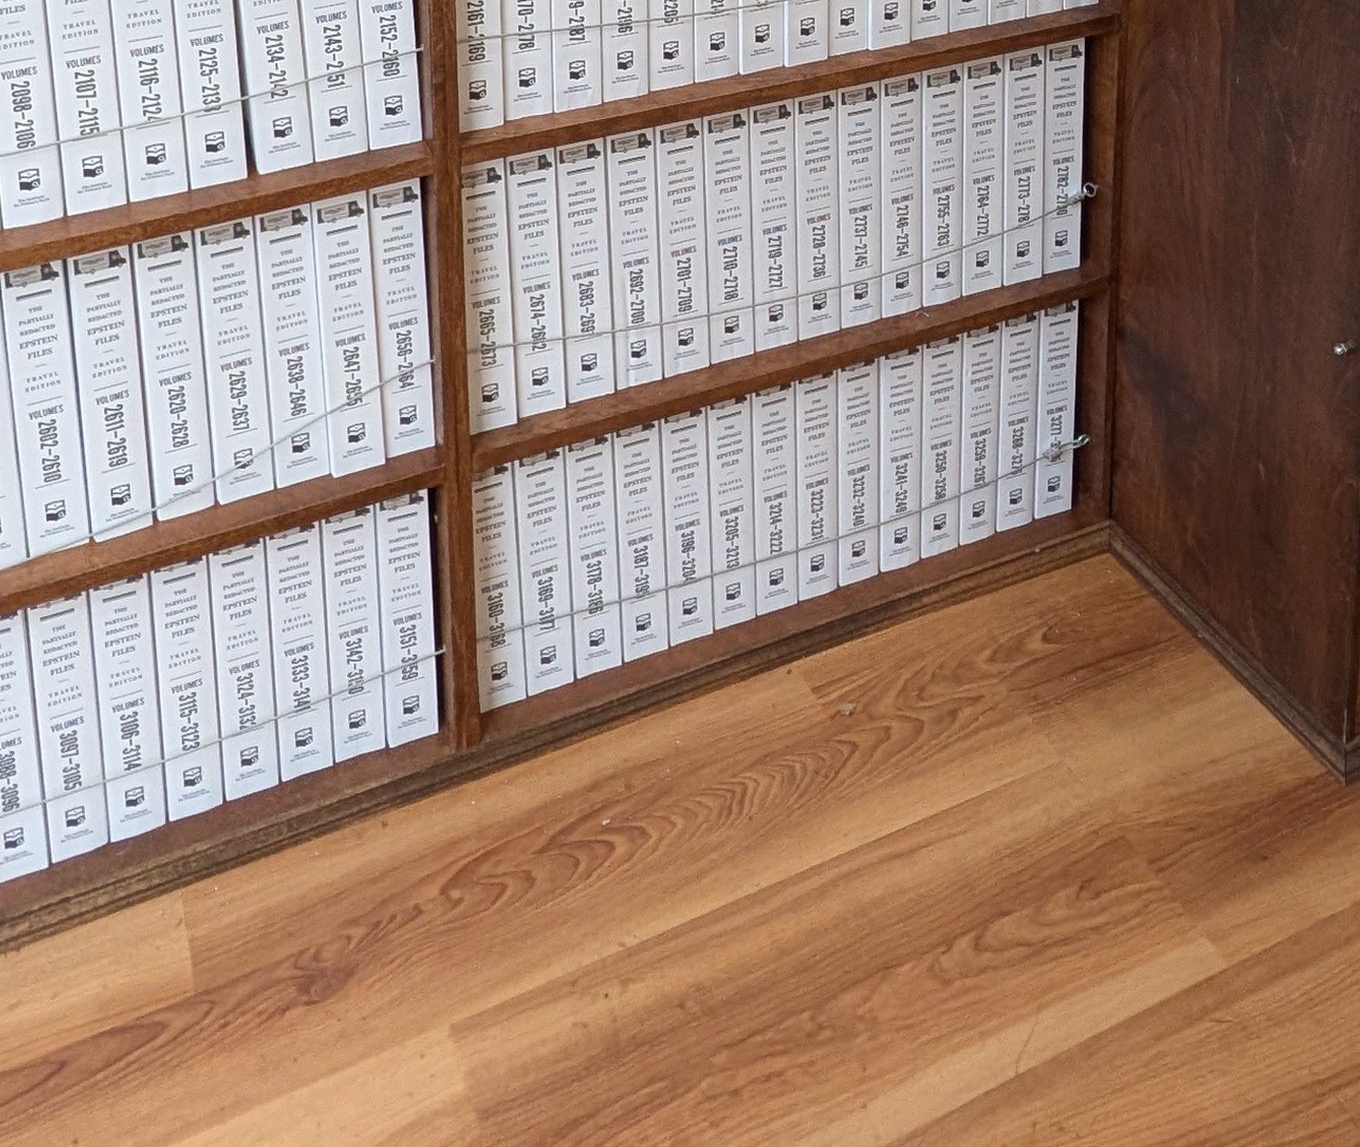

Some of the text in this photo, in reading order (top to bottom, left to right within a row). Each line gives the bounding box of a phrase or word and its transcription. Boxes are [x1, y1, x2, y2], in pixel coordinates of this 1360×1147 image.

[73, 69, 103, 136] 2107-2115
[9, 79, 37, 150] 2098-2106
[760, 166, 787, 177] EPSTEIN
[764, 176, 783, 185] FILES
[762, 224, 788, 236] VOLUMES
[42, 651, 80, 665] EPSTEIN
[49, 662, 77, 676] FILES
[50, 716, 84, 732] VOLUMES
